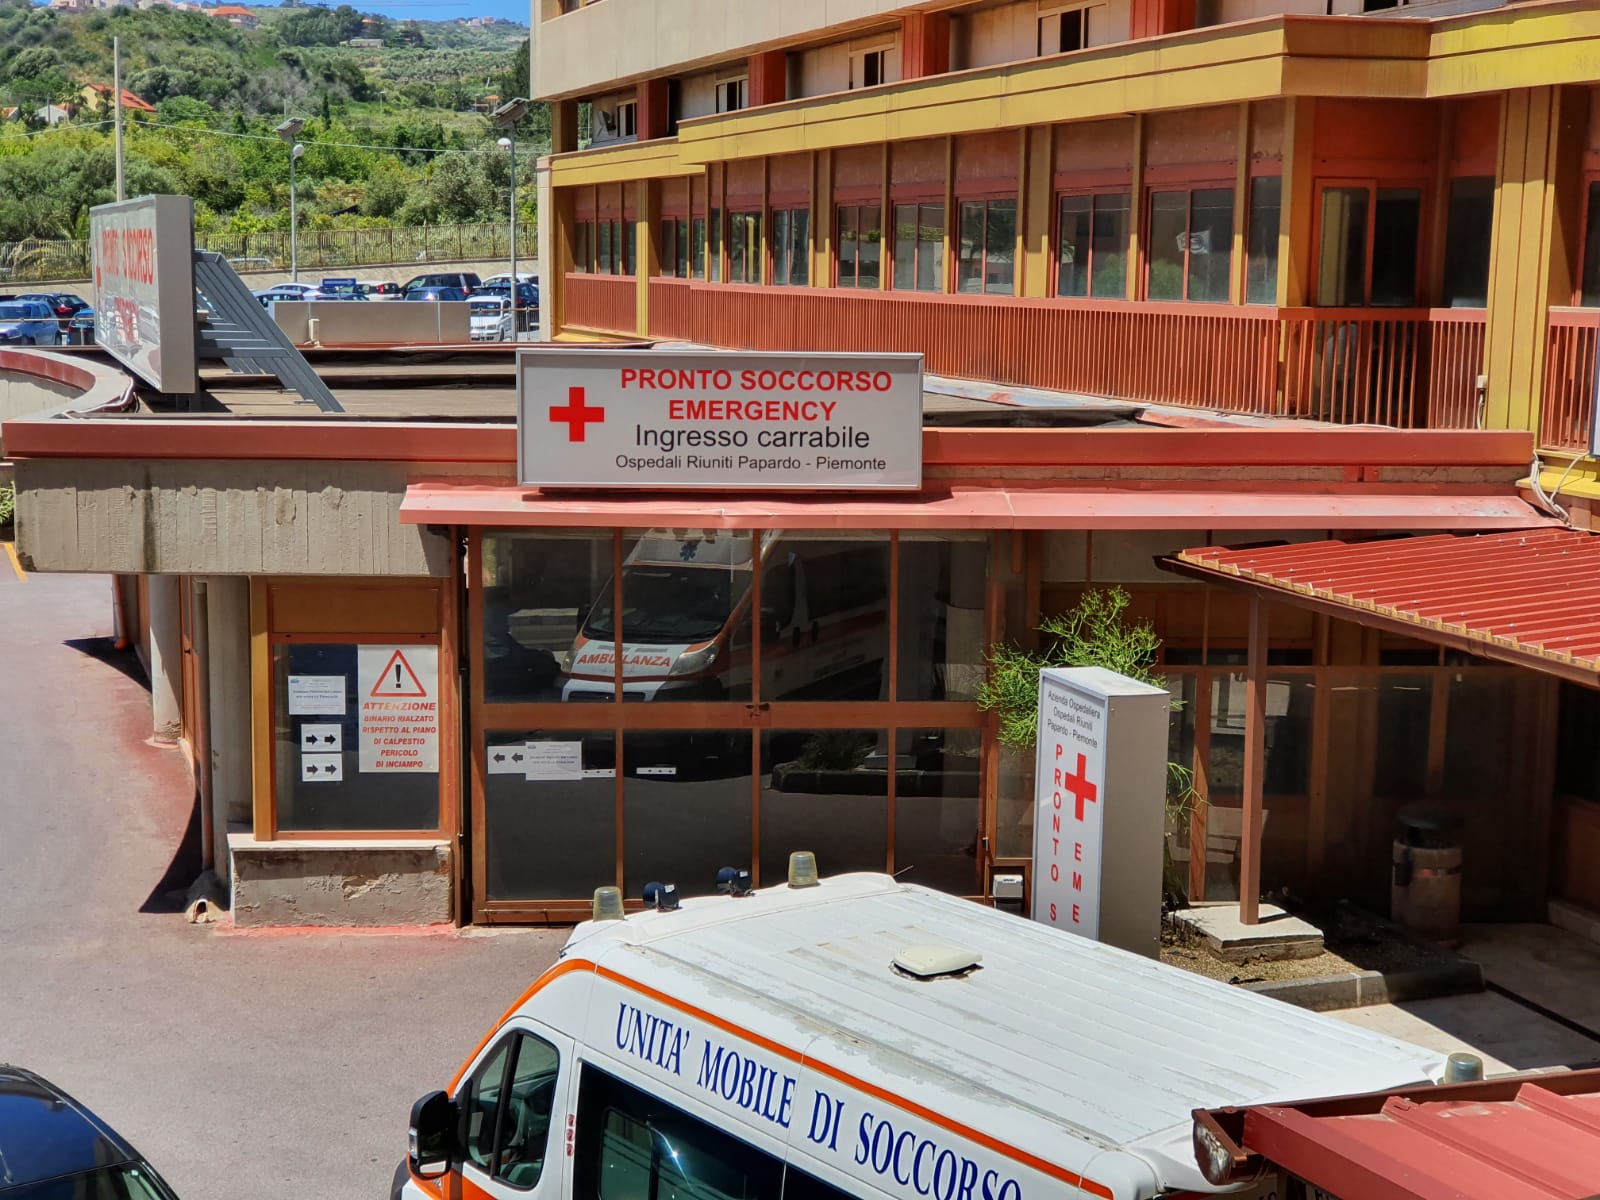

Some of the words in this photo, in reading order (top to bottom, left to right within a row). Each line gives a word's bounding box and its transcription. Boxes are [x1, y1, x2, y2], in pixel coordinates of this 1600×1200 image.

[620, 368, 733, 391] PRONTO
[740, 370, 893, 392] SOCCORSO
[668, 399, 837, 422] EMERGENCY
[636, 424, 748, 452] Ingresso
[757, 425, 870, 449] carrabile
[615, 454, 682, 472] Ospedali
[686, 454, 733, 470] Riuniti
[738, 455, 801, 473] Papardo
[816, 455, 887, 471] Piemonte
[578, 653, 671, 667] AMBULANZA
[362, 702, 437, 711] ATTENZIONE
[1047, 690, 1068, 706] Azienda
[1069, 698, 1101, 719] Ospedaliera
[362, 726, 399, 734] RISPETTO
[401, 726, 410, 734] AL
[412, 726, 437, 734] PIANO
[1053, 706, 1075, 724] Ospedali
[1076, 715, 1093, 732] Riuniti
[383, 737, 426, 745] CALPESTIO
[1047, 718, 1068, 736] Papardo
[1073, 729, 1098, 749] Piemonte
[375, 760, 384, 769] DI
[385, 760, 423, 768] INCIAMPO
[380, 749, 419, 757] PERICOLO
[1050, 743, 1063, 882] PRONTO
[616, 1002, 691, 1076] UNITA'
[696, 1039, 797, 1129] MOBILE
[807, 1089, 845, 1151] DI
